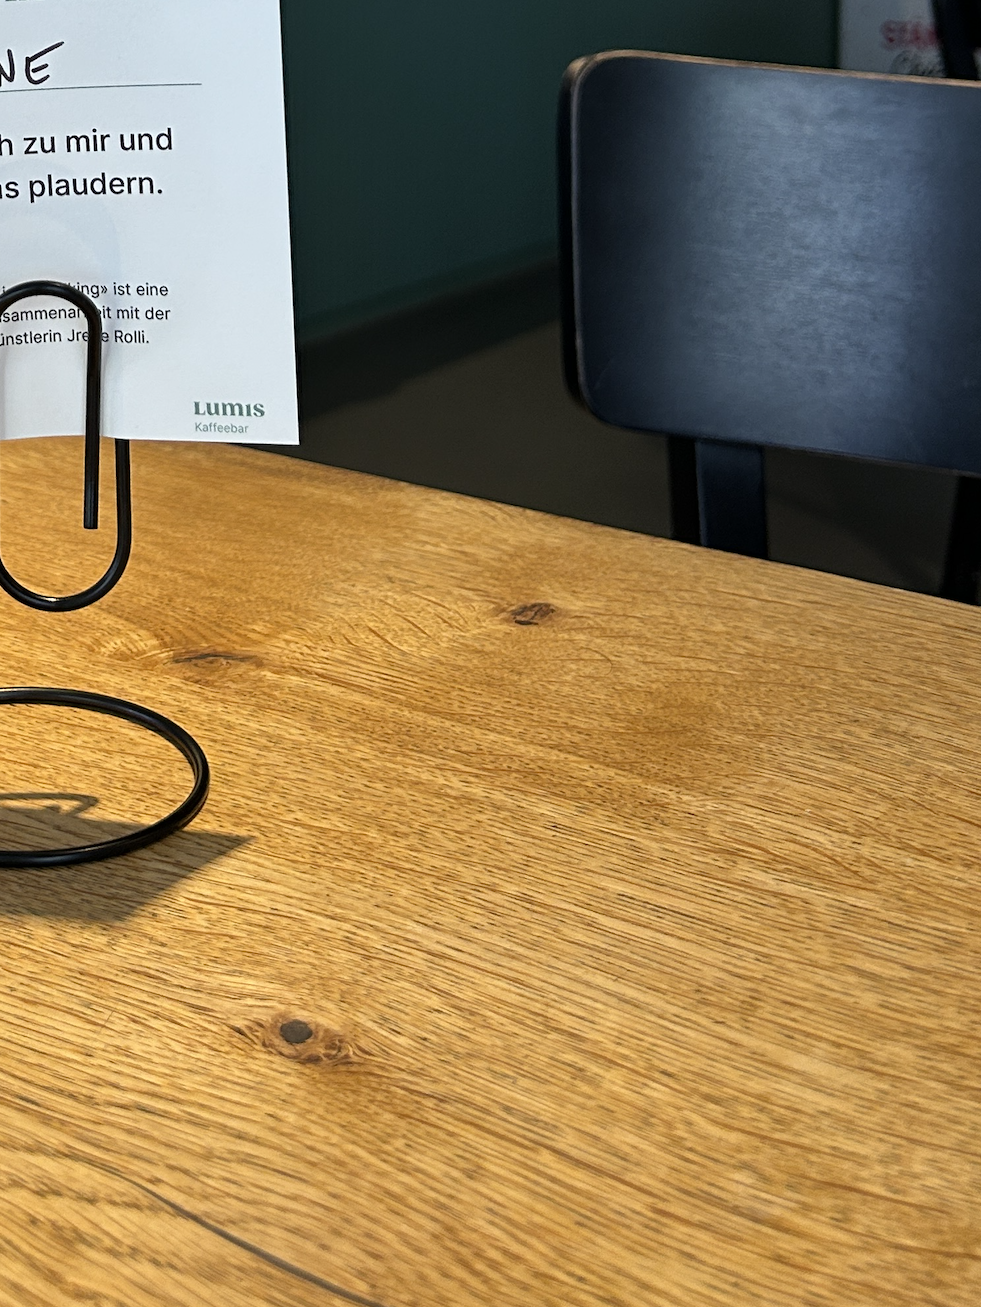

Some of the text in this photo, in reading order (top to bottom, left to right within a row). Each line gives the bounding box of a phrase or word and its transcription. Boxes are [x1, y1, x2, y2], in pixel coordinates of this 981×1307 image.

[23, 135, 56, 155] zu
[66, 128, 111, 153] mir
[119, 127, 173, 152] und
[29, 172, 163, 204] plaudern.
[113, 282, 131, 296] ist
[136, 282, 169, 297] eine
[116, 304, 140, 320] mit
[145, 304, 171, 320] der
[67, 328, 109, 343] Jree
[114, 329, 150, 344] Rolli.
[195, 422, 249, 434] Kaffeebar
